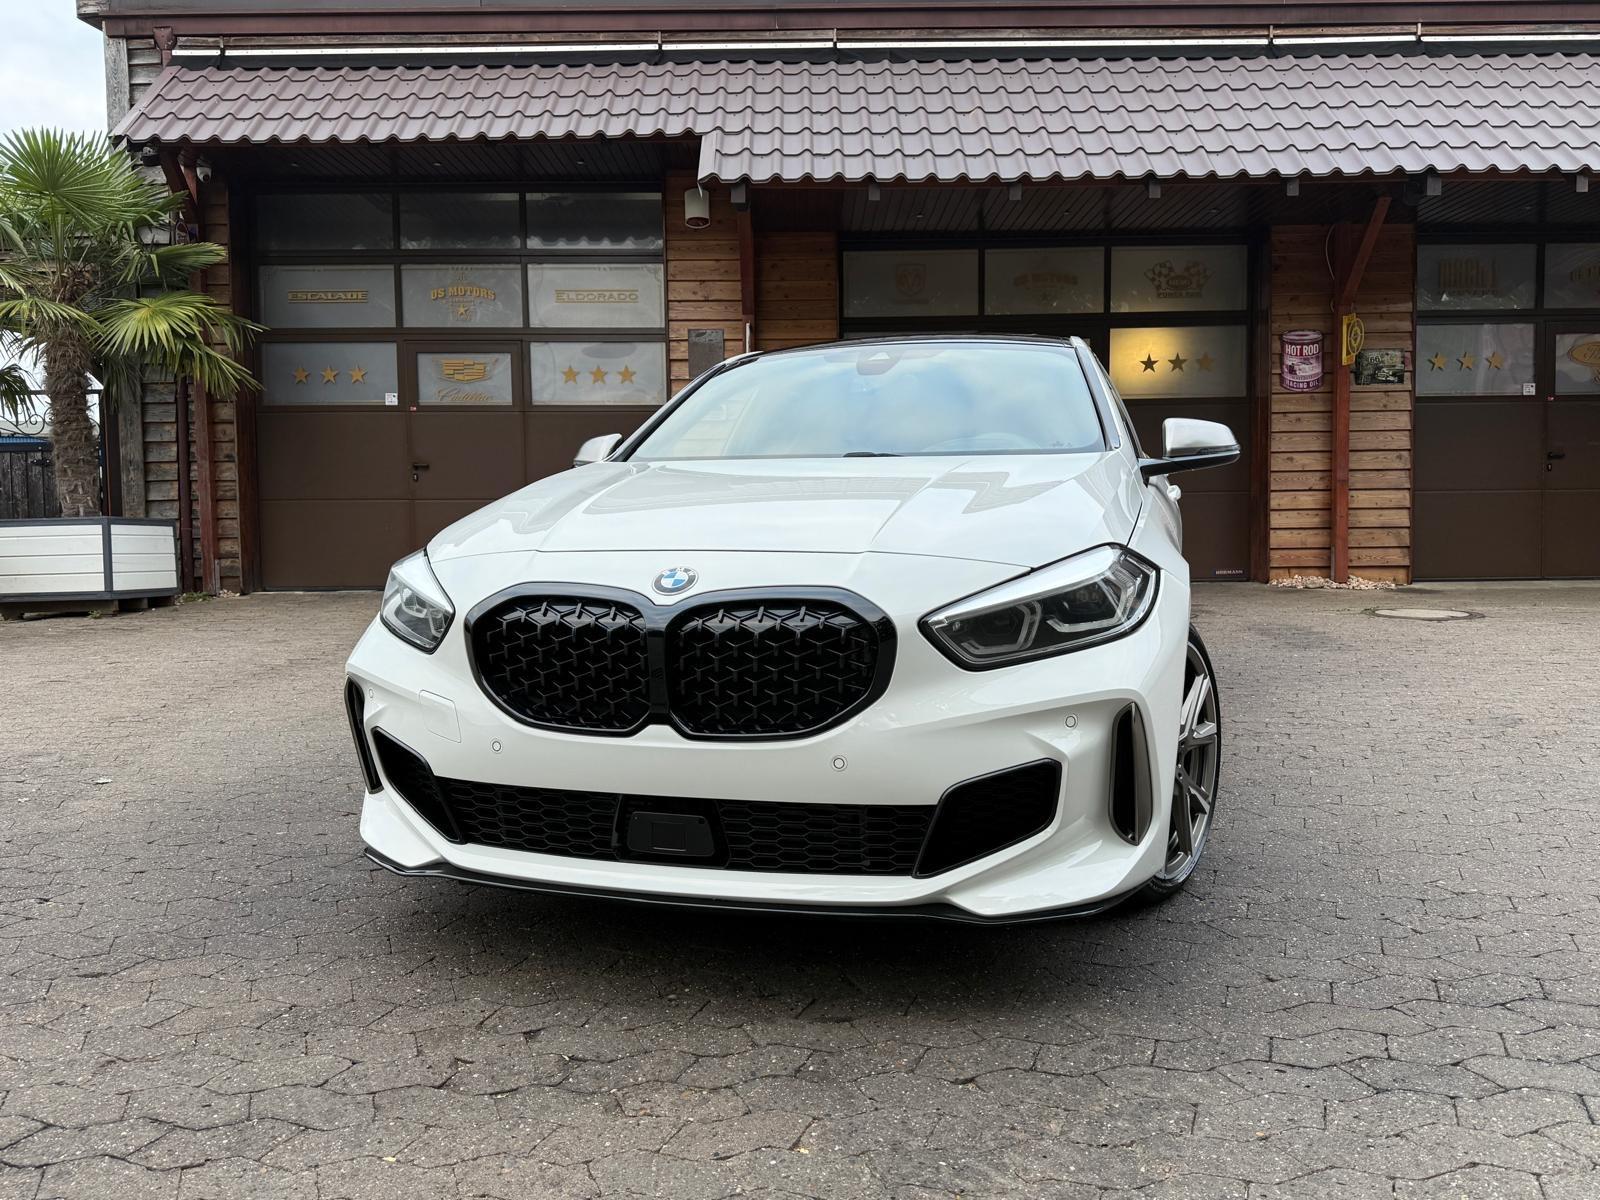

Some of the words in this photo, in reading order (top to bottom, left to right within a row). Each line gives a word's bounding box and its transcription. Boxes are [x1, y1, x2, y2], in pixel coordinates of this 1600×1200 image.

[288, 291, 369, 301] ESCALADE
[431, 288, 445, 300] US
[448, 287, 496, 300] MOTORS
[555, 291, 639, 302] ELDORADO
[1285, 344, 1301, 356] HOT
[1303, 343, 1319, 356] ROD
